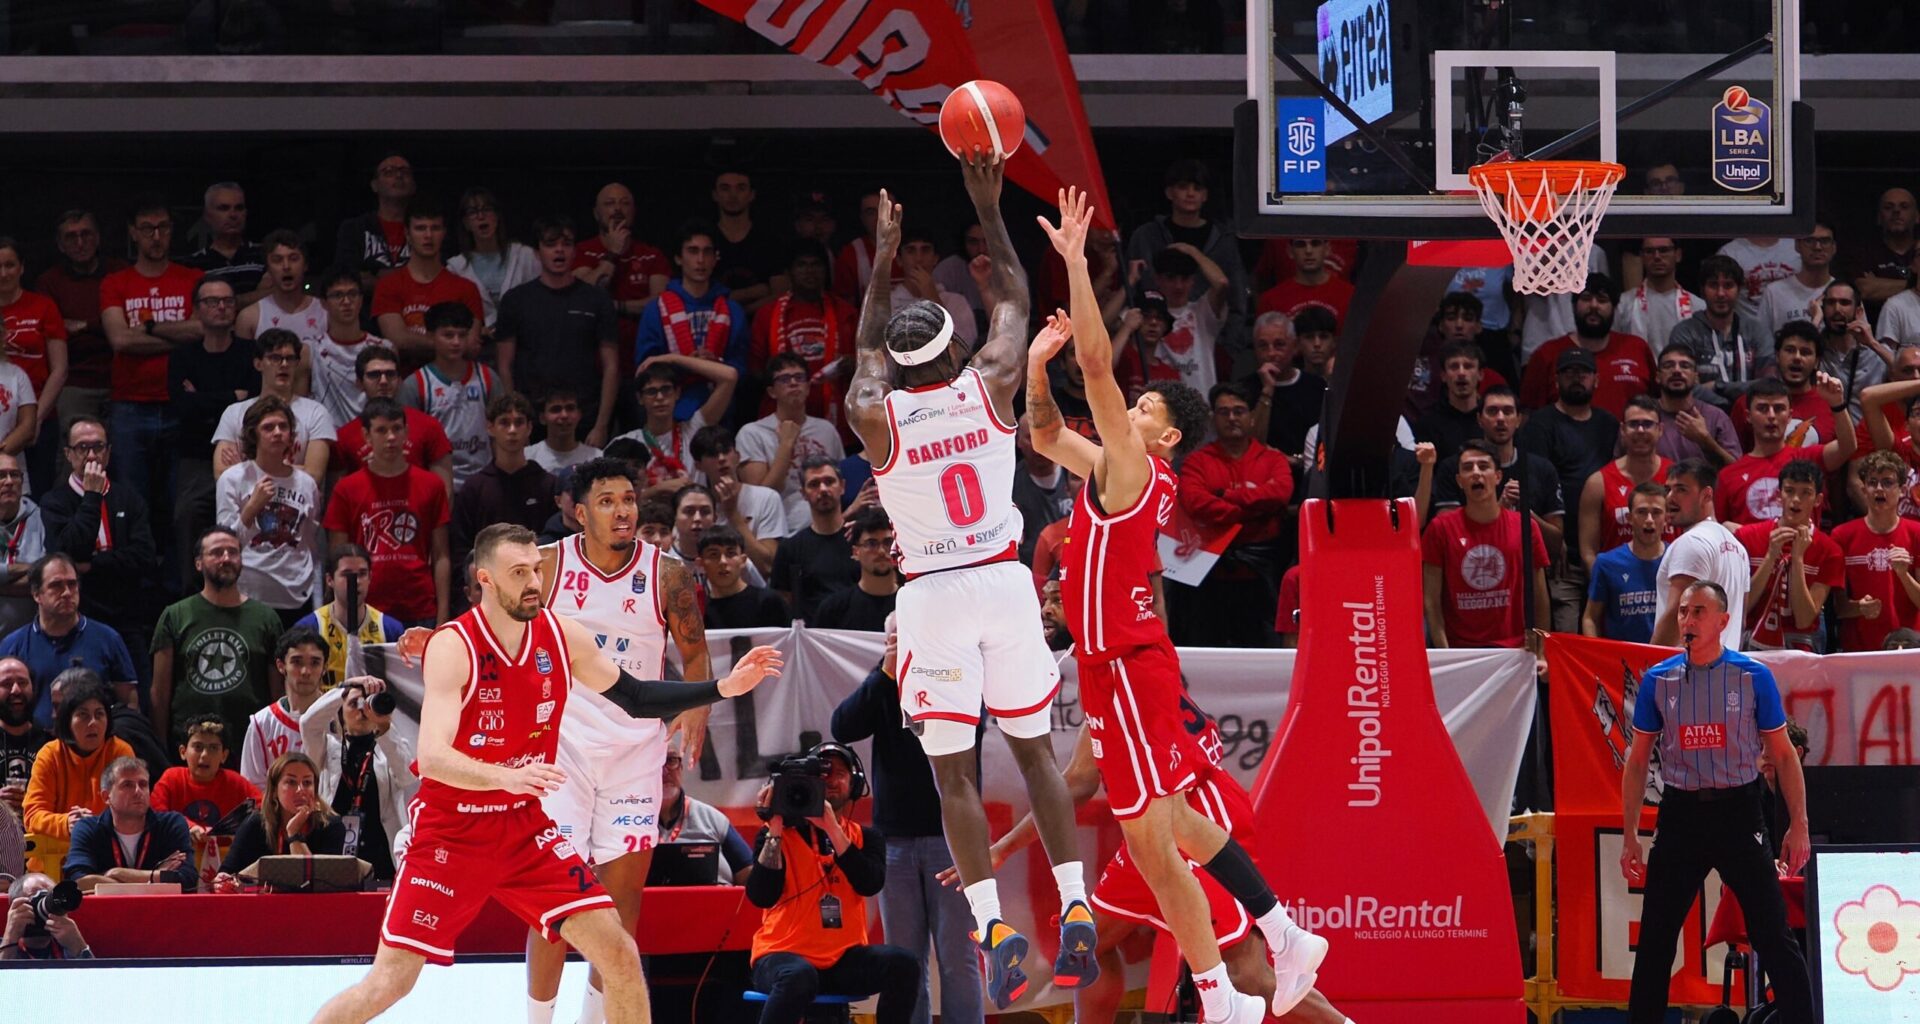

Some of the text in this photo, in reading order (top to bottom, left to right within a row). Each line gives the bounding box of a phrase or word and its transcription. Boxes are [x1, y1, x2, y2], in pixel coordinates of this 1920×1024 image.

[1721, 129, 1764, 145] LBA
[1284, 160, 1320, 173] FIP
[1725, 164, 1760, 180] Unipol
[164, 296, 185, 309] MY
[897, 409, 945, 428] BANCO BPM
[906, 428, 989, 465] BARFORD
[938, 462, 987, 528] 0
[924, 537, 957, 556] iren
[563, 570, 590, 592] 26
[1374, 574, 1385, 616] TERMINE
[1458, 597, 1510, 610] REGGIANA
[1377, 618, 1387, 650] LUNGO
[1380, 660, 1391, 708] NOLEGGIO
[478, 688, 502, 700] EA7
[1342, 601, 1392, 807] UnipolRental
[488, 736, 505, 744] Group
[1685, 725, 1721, 737] ATTAL
[1684, 737, 1721, 746] GROUP
[623, 835, 652, 853] 26
[410, 876, 455, 898] DRIVALIA
[412, 909, 440, 927] EA7
[1355, 926, 1489, 940] NOLEGGIO A LUNGO TERMINE
